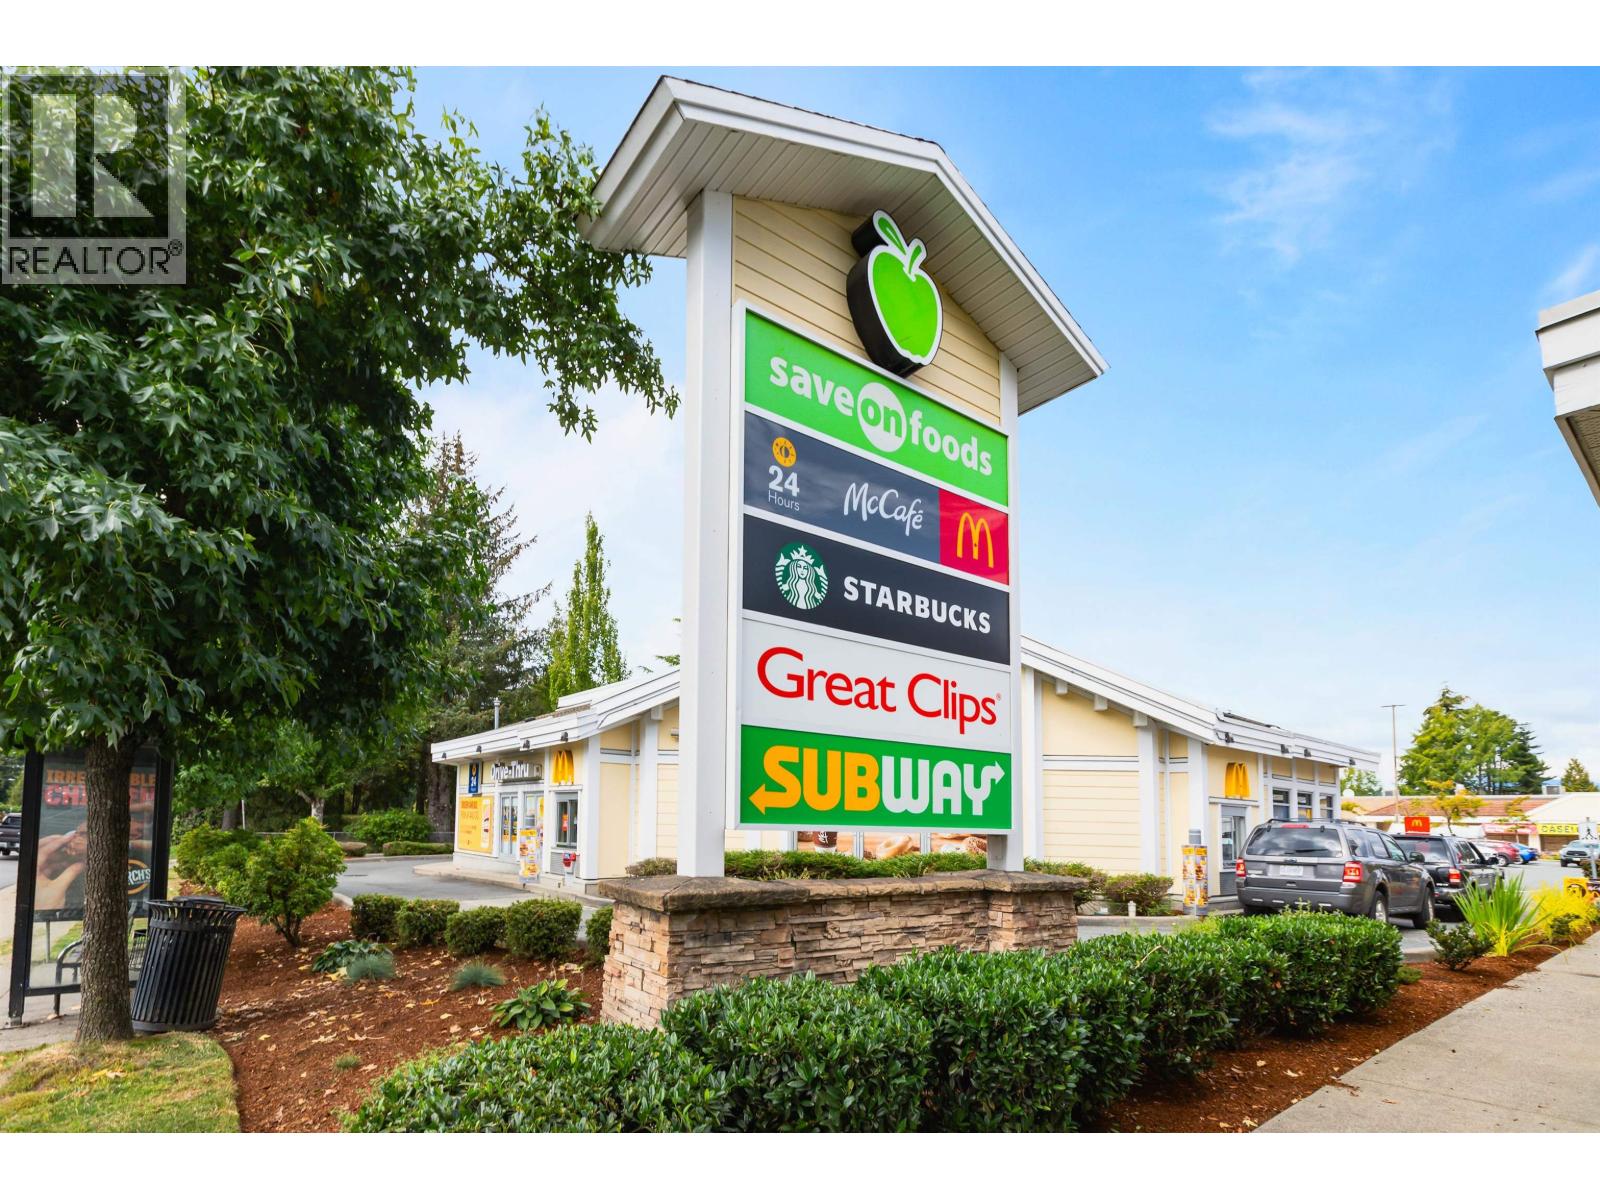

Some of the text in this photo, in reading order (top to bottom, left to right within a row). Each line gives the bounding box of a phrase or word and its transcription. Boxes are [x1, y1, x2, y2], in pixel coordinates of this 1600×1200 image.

[768, 464, 800, 497] 24
[768, 489, 800, 511] Hours
[843, 482, 924, 537] McCafé
[843, 575, 991, 634] STARBUCKS
[757, 646, 997, 735] Great Clips
[490, 761, 529, 782] Drive-Thru
[748, 745, 1005, 815] SUBWAY
